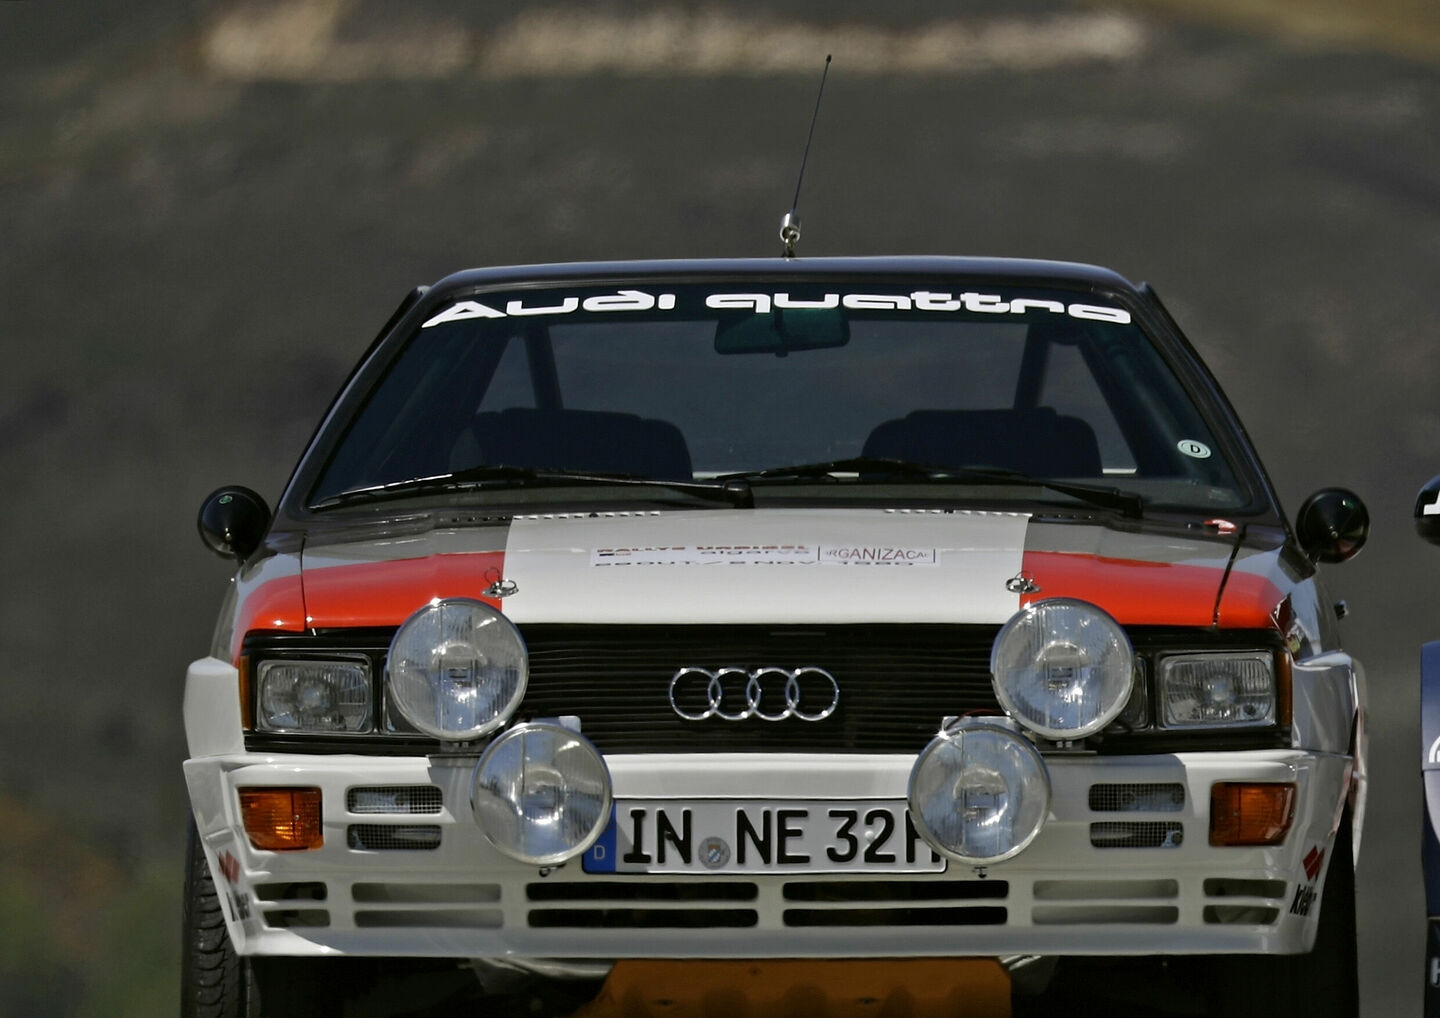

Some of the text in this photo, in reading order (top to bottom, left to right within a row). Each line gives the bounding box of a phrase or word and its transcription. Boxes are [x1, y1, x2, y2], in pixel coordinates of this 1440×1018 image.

[421, 290, 1131, 329] Audi quattro
[593, 844, 605, 860] D
[623, 808, 692, 864] IN
[736, 808, 811, 864] NE
